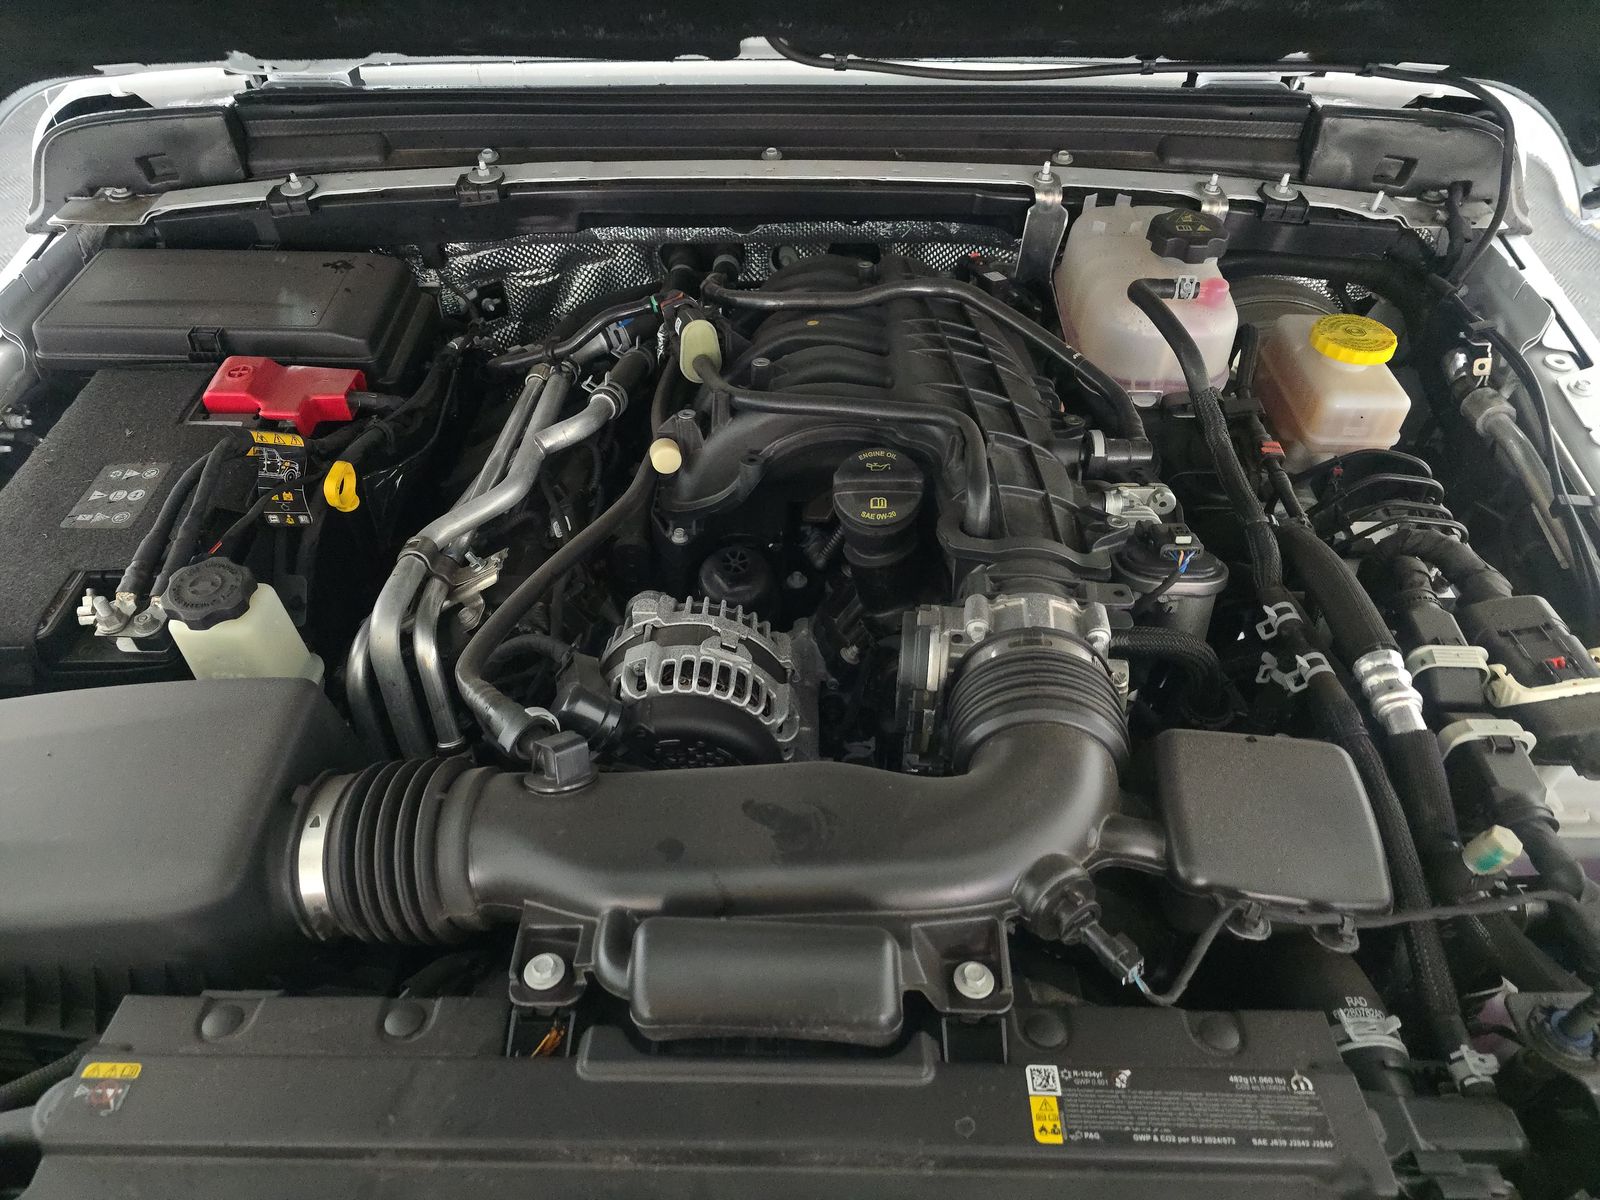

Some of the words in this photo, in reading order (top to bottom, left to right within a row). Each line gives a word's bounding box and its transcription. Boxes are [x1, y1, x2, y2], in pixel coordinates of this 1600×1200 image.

[858, 451, 885, 461] ENGINE
[886, 452, 897, 460] OIL
[860, 511, 875, 520] SAE
[876, 511, 897, 521] 0W-20
[1345, 996, 1368, 1007] RAD
[1084, 1132, 1100, 1140] PAG
[1133, 1134, 1151, 1142] GWP
[1160, 1134, 1176, 1142] CO2
[1177, 1136, 1190, 1144] per
[1191, 1135, 1202, 1143] EU
[1251, 1138, 1268, 1146] SAE
